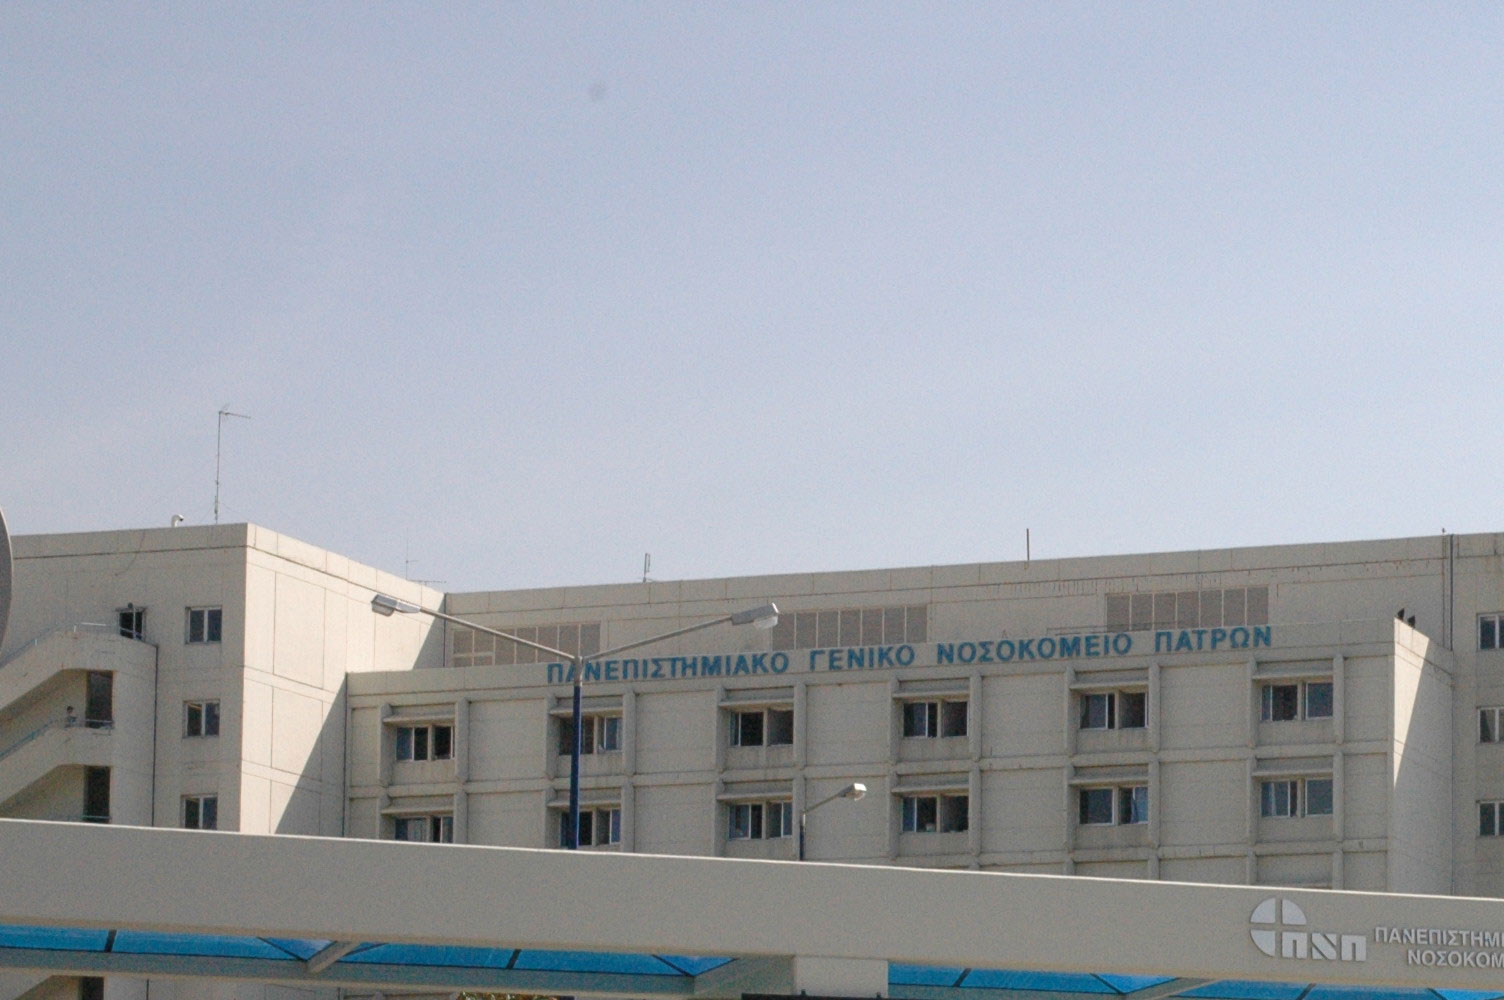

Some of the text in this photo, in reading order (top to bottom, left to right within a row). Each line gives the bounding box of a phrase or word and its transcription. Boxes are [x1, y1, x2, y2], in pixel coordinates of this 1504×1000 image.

[809, 645, 916, 672] ΓΕΝΙΚΟ
[936, 632, 1133, 665] ΝΟΣΟΚΟΜΕΙΟ
[1154, 625, 1272, 653] ΠΑΤΡΩΝ
